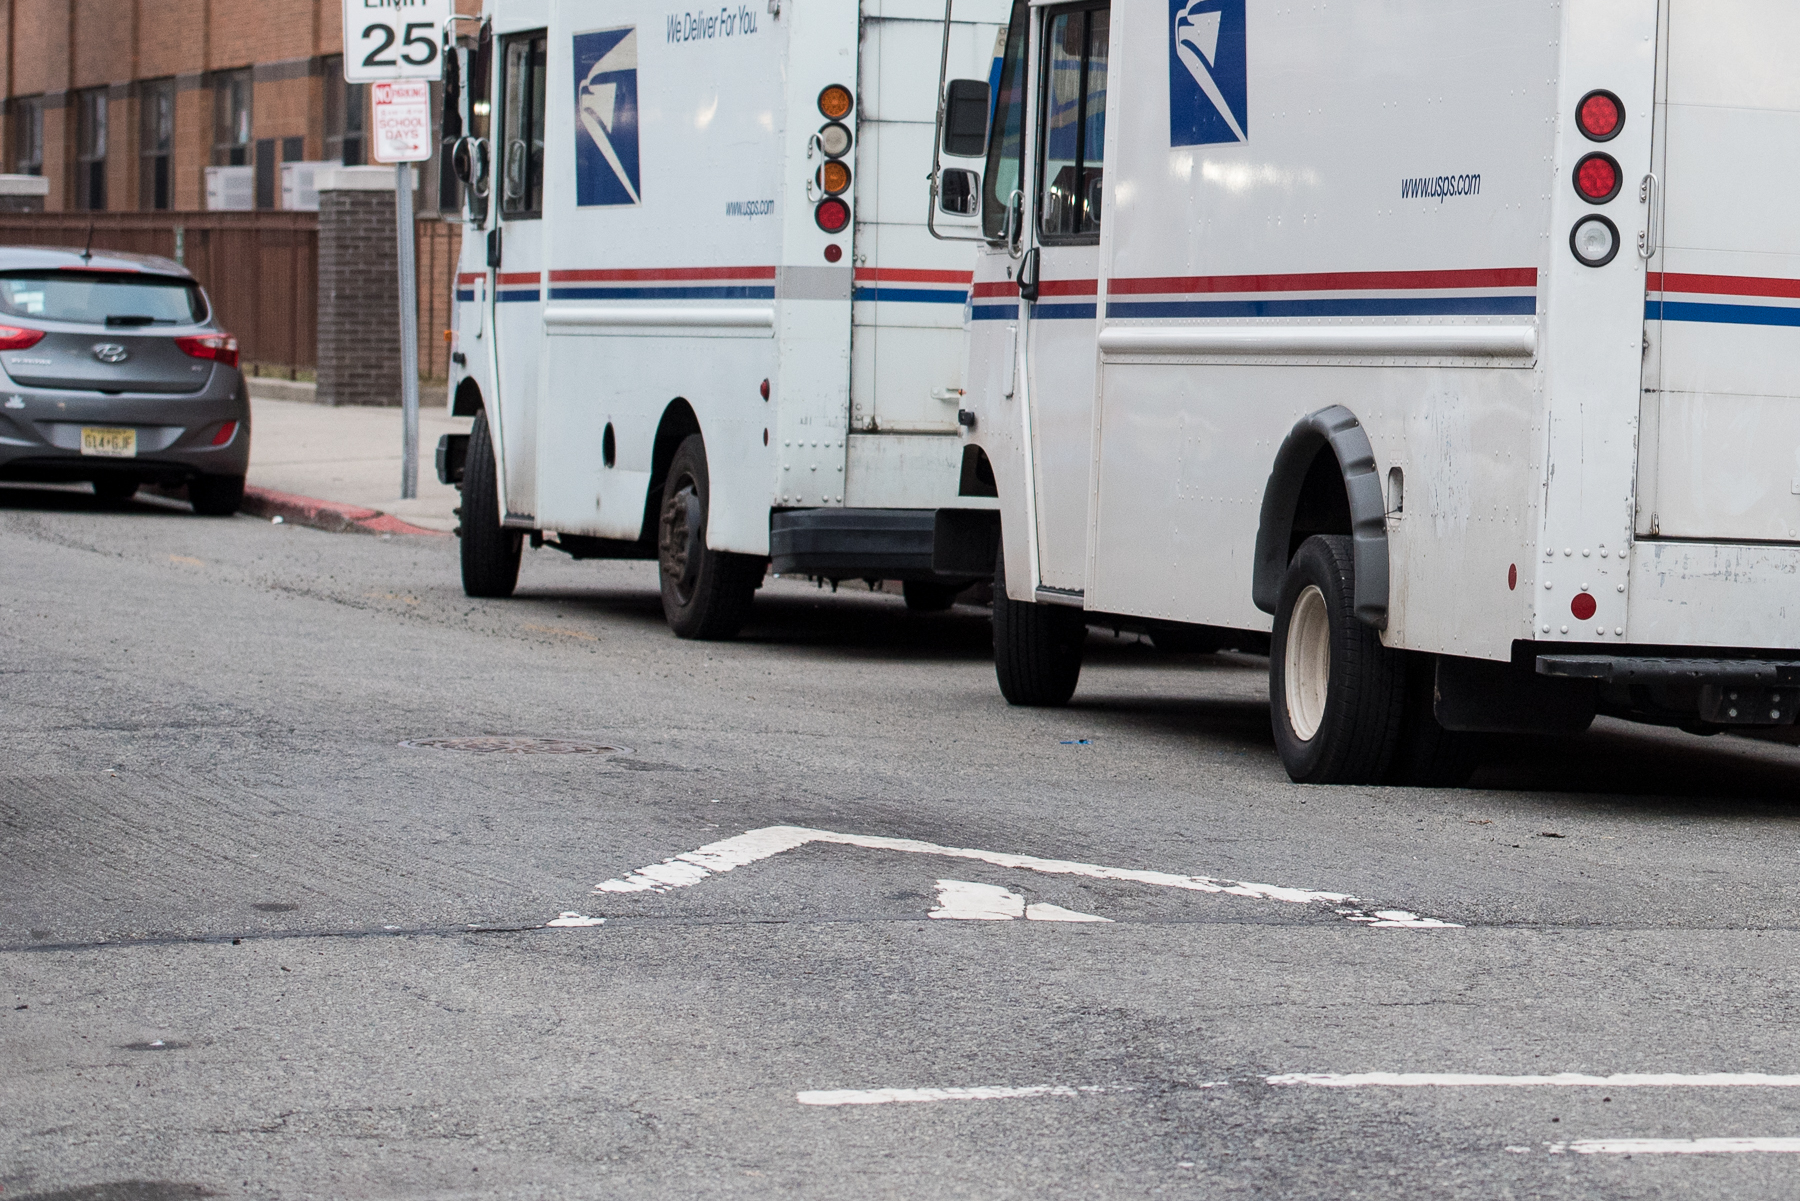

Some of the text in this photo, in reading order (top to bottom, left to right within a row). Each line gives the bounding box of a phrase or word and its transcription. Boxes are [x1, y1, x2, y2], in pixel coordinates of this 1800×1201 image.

[666, 4, 758, 44] We Deliver For You.
[361, 23, 438, 67] 25
[376, 86, 393, 103] NO
[379, 118, 425, 129] SCHOOL
[385, 129, 419, 140] DAYS
[1401, 173, 1481, 204] www.usps.com
